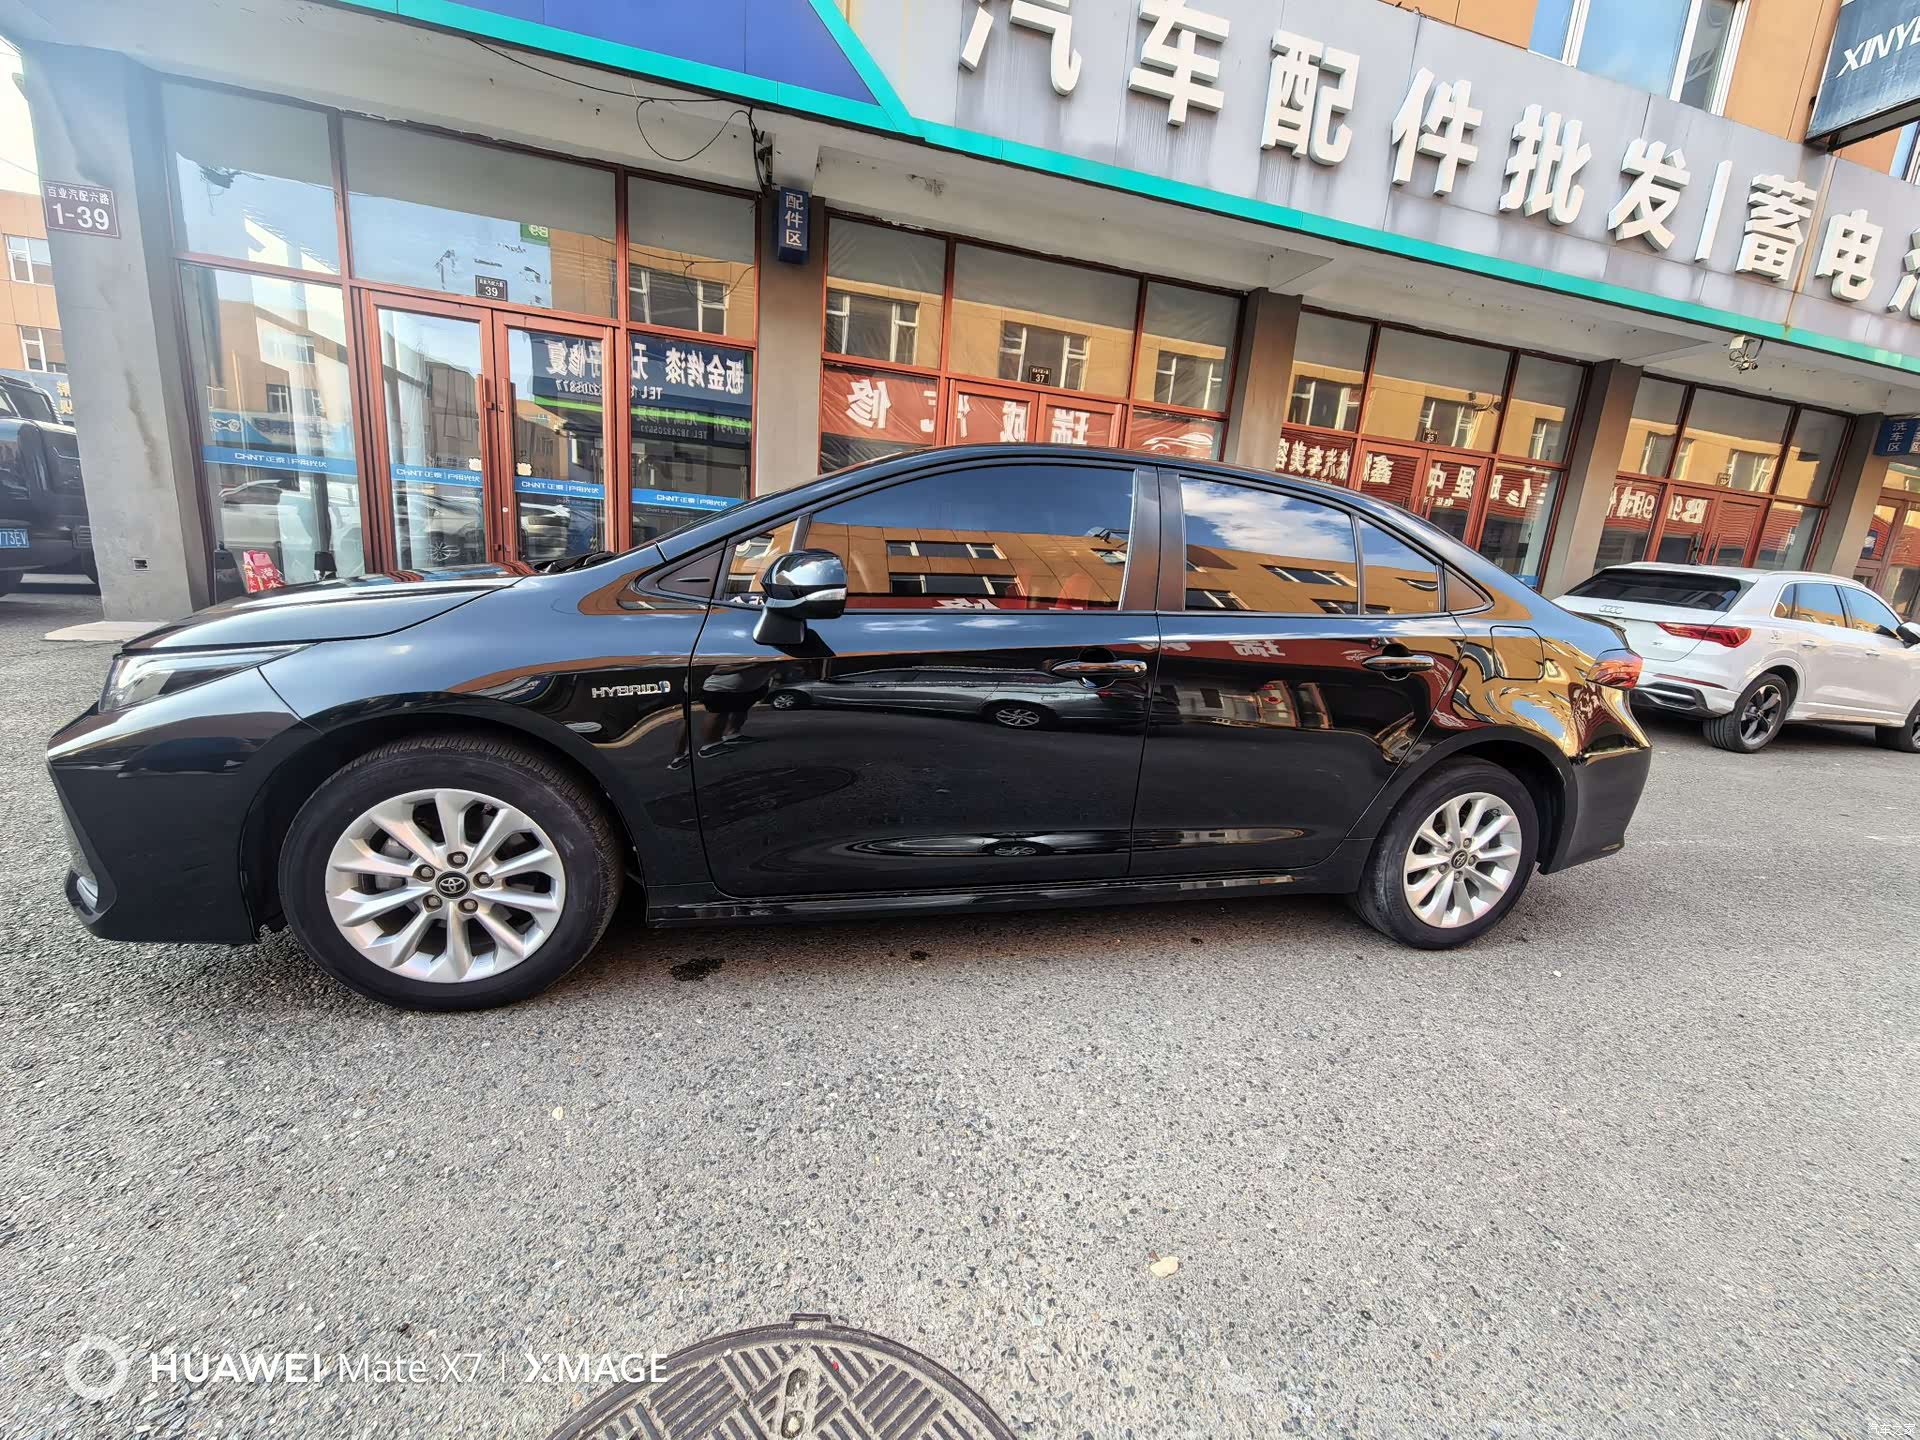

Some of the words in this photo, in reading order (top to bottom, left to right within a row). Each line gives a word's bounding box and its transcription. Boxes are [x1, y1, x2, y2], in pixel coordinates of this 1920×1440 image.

[47, 186, 109, 205] 百业汽配六路
[52, 202, 110, 230] 1-39
[784, 192, 804, 247] 配件区
[485, 286, 498, 297] 39
[1035, 373, 1045, 383] 37
[0, 530, 27, 545] 73EV
[591, 684, 659, 698] HYBRID
